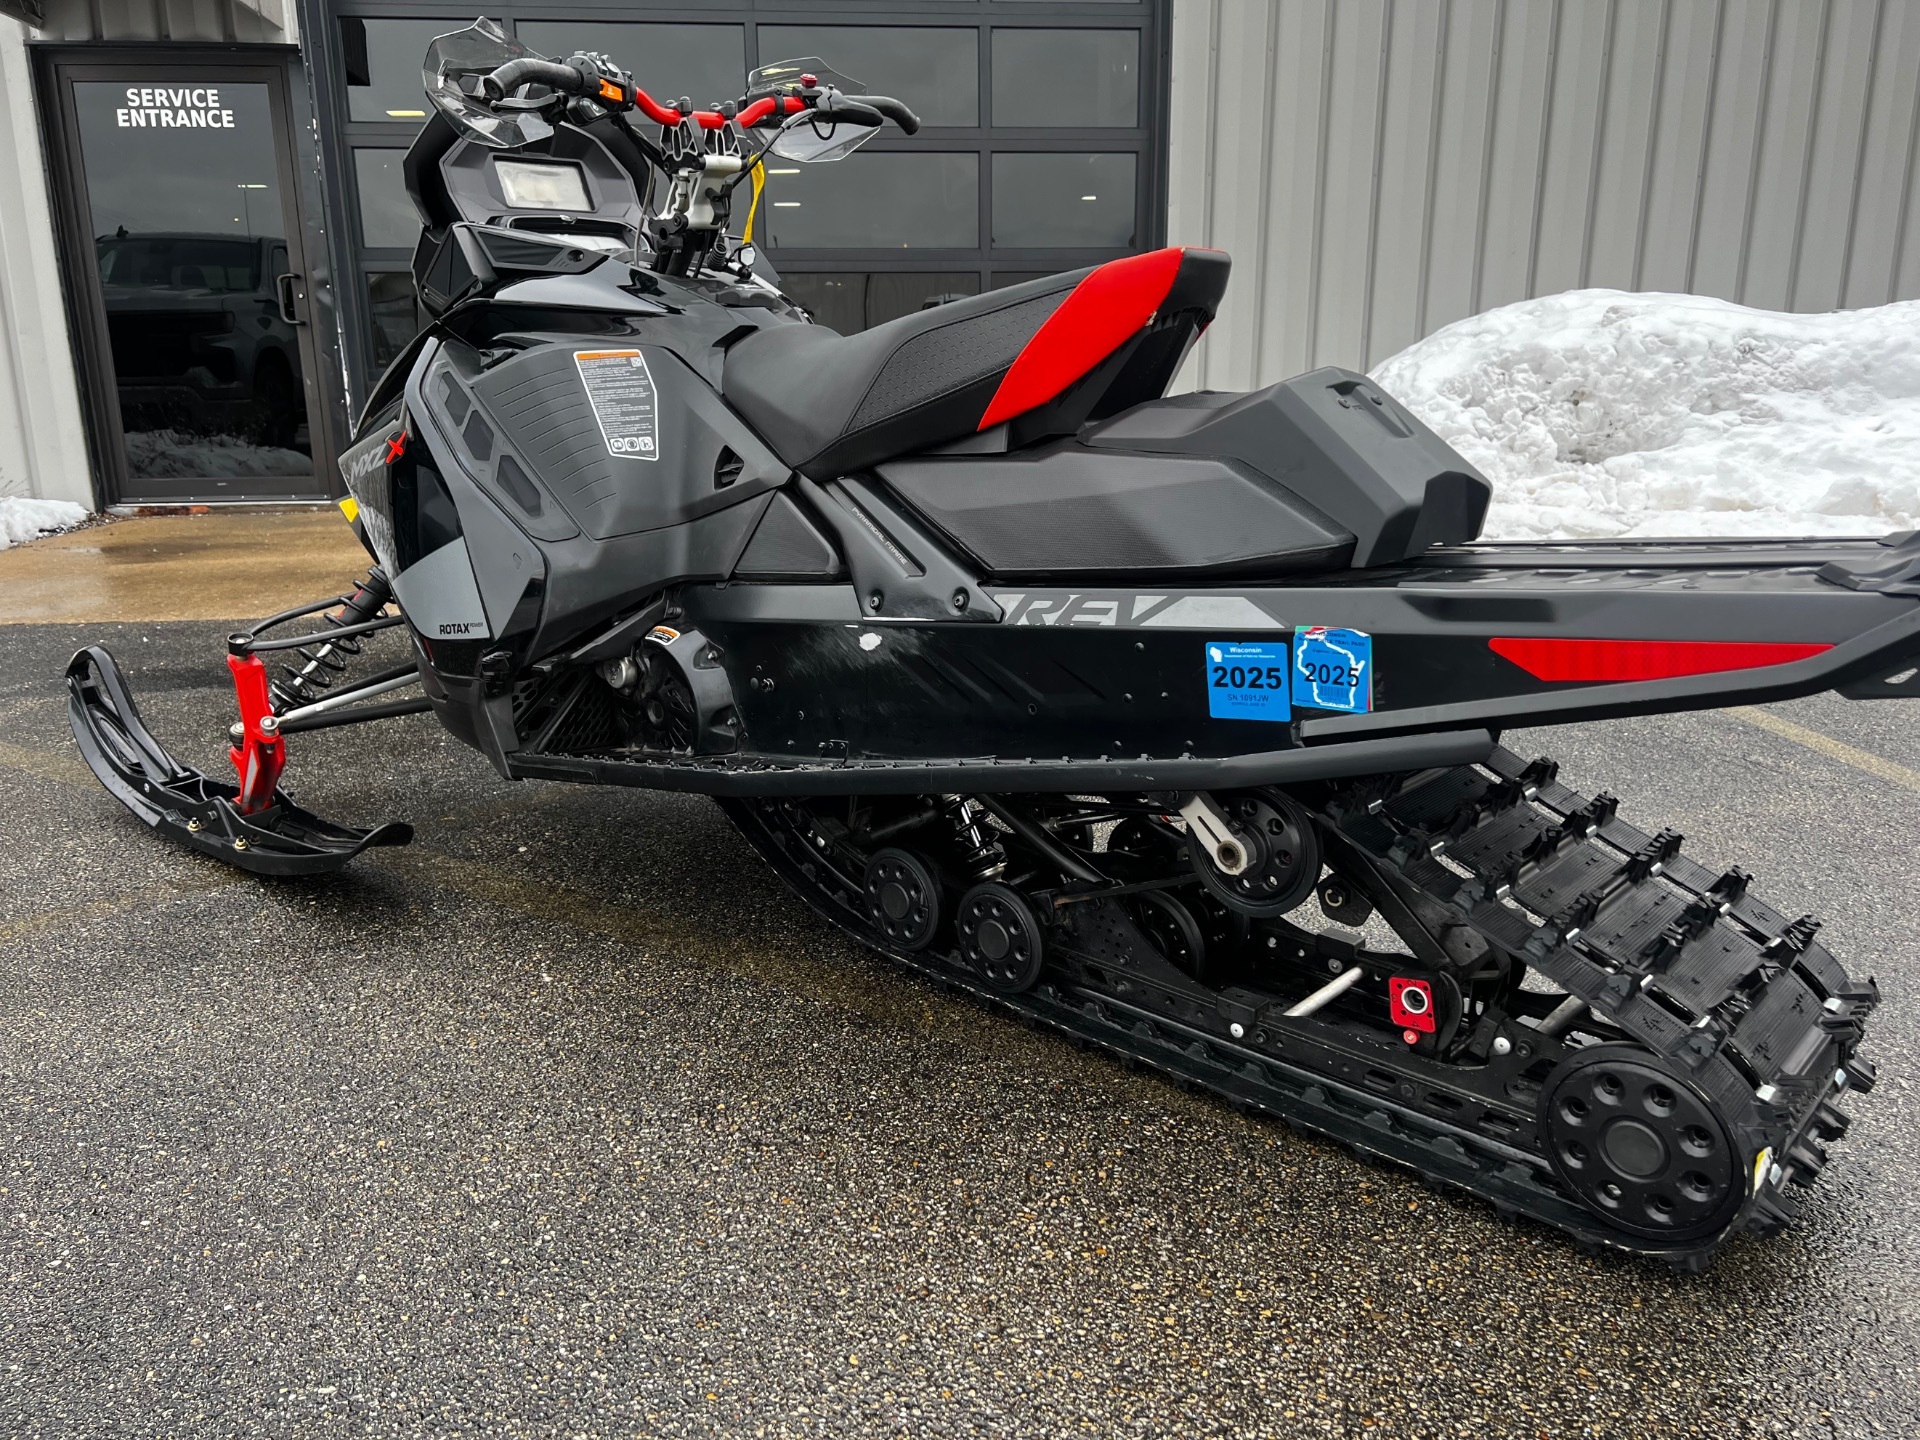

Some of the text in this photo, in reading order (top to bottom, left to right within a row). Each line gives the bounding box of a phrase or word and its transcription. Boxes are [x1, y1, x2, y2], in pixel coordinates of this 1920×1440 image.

[126, 88, 220, 108] SERVICE
[116, 108, 235, 128] ENTRANCE
[350, 429, 407, 486] MXZ X
[852, 507, 908, 565] PYRAMIDAL FRAME
[1004, 594, 1186, 627] REV
[439, 623, 470, 635] ROTAX
[1213, 665, 1282, 690] 2025
[1304, 662, 1360, 688] 2025
